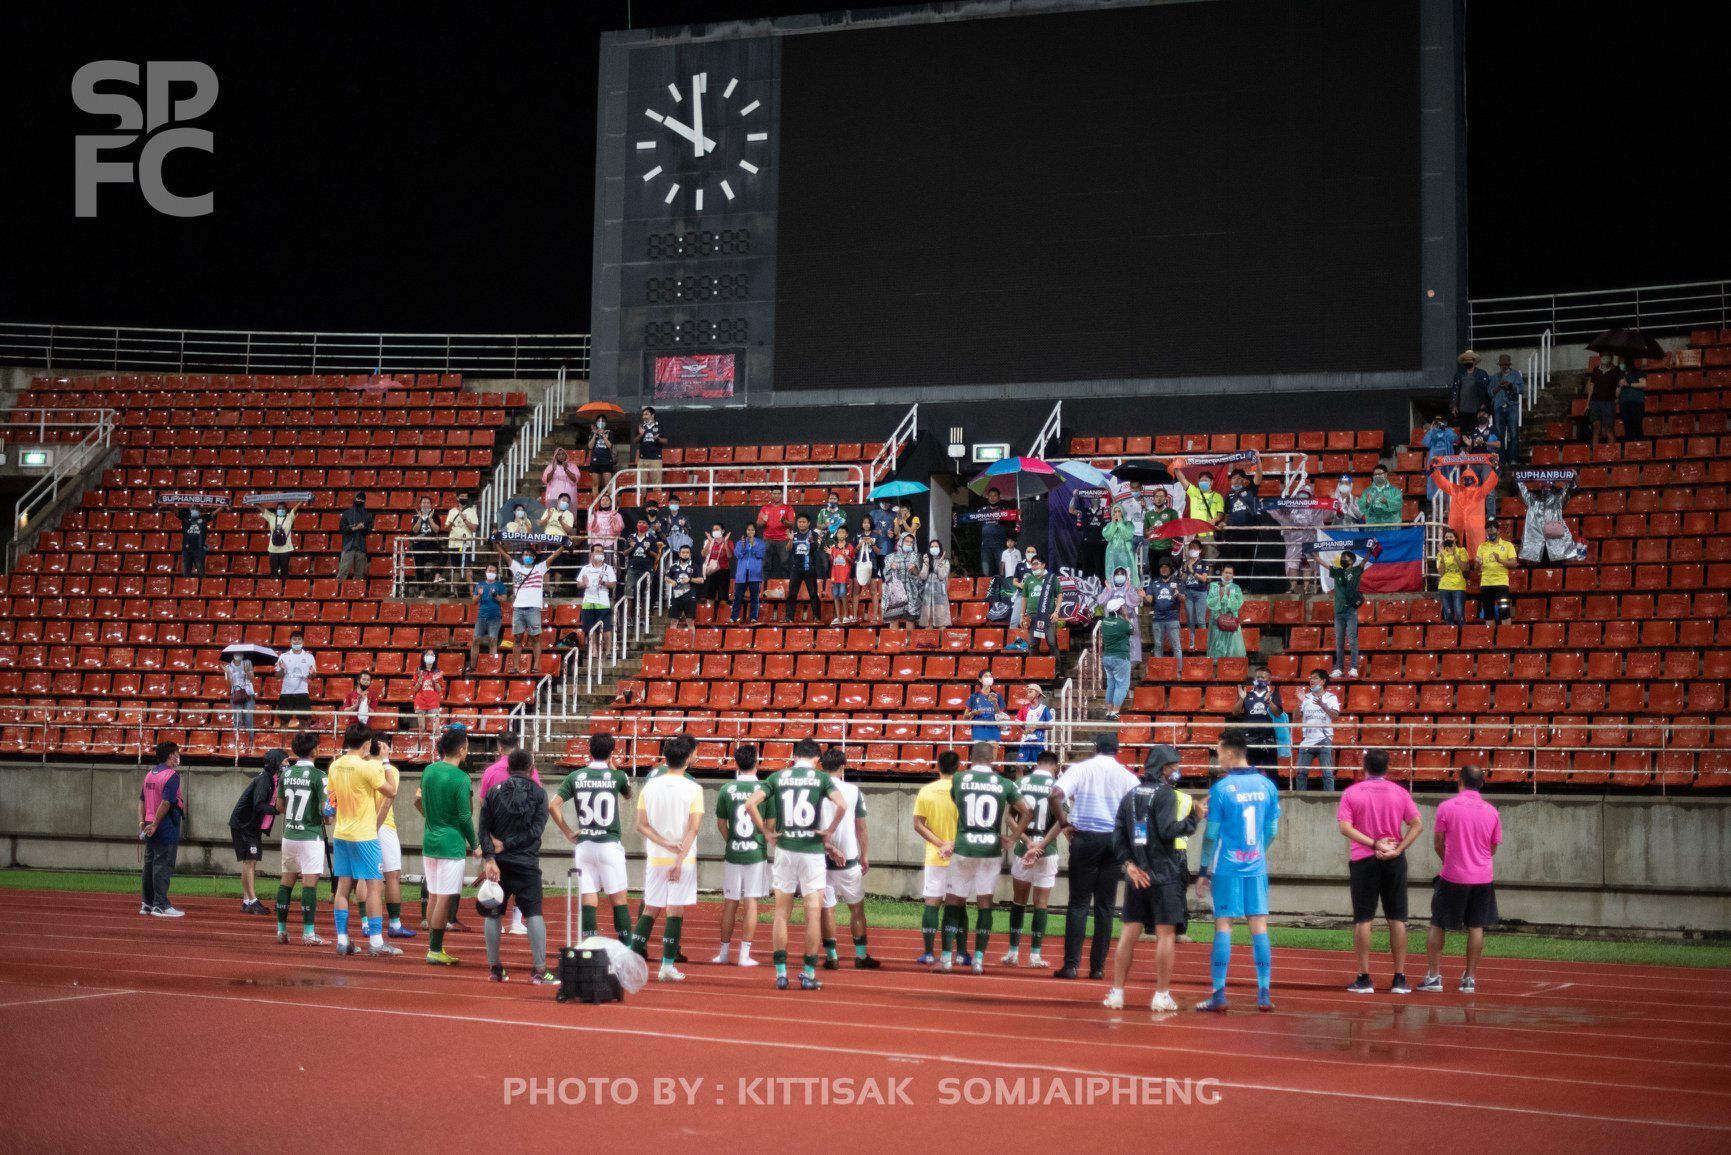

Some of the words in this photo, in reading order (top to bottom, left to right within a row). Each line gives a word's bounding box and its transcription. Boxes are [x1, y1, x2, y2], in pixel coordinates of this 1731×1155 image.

[1515, 471, 1574, 480] SUPHANBURI
[162, 495, 213, 503] SUPHANBURI
[969, 512, 1008, 520] SUPHANBURI
[502, 532, 563, 542] SUPHANBURI
[1313, 540, 1354, 549] SUPHANBURI
[574, 780, 617, 789] RATCHANAT
[960, 782, 1004, 793] ELIANDRO
[731, 792, 752, 801] PRAS
[1236, 792, 1265, 802] DEYTO
[576, 791, 616, 827] 30
[781, 788, 816, 827] 16
[964, 792, 998, 828] 10
[735, 803, 755, 838] 8
[1242, 805, 1257, 846] 1
[784, 830, 816, 838] true
[966, 832, 997, 844] true
[731, 840, 759, 851] true
